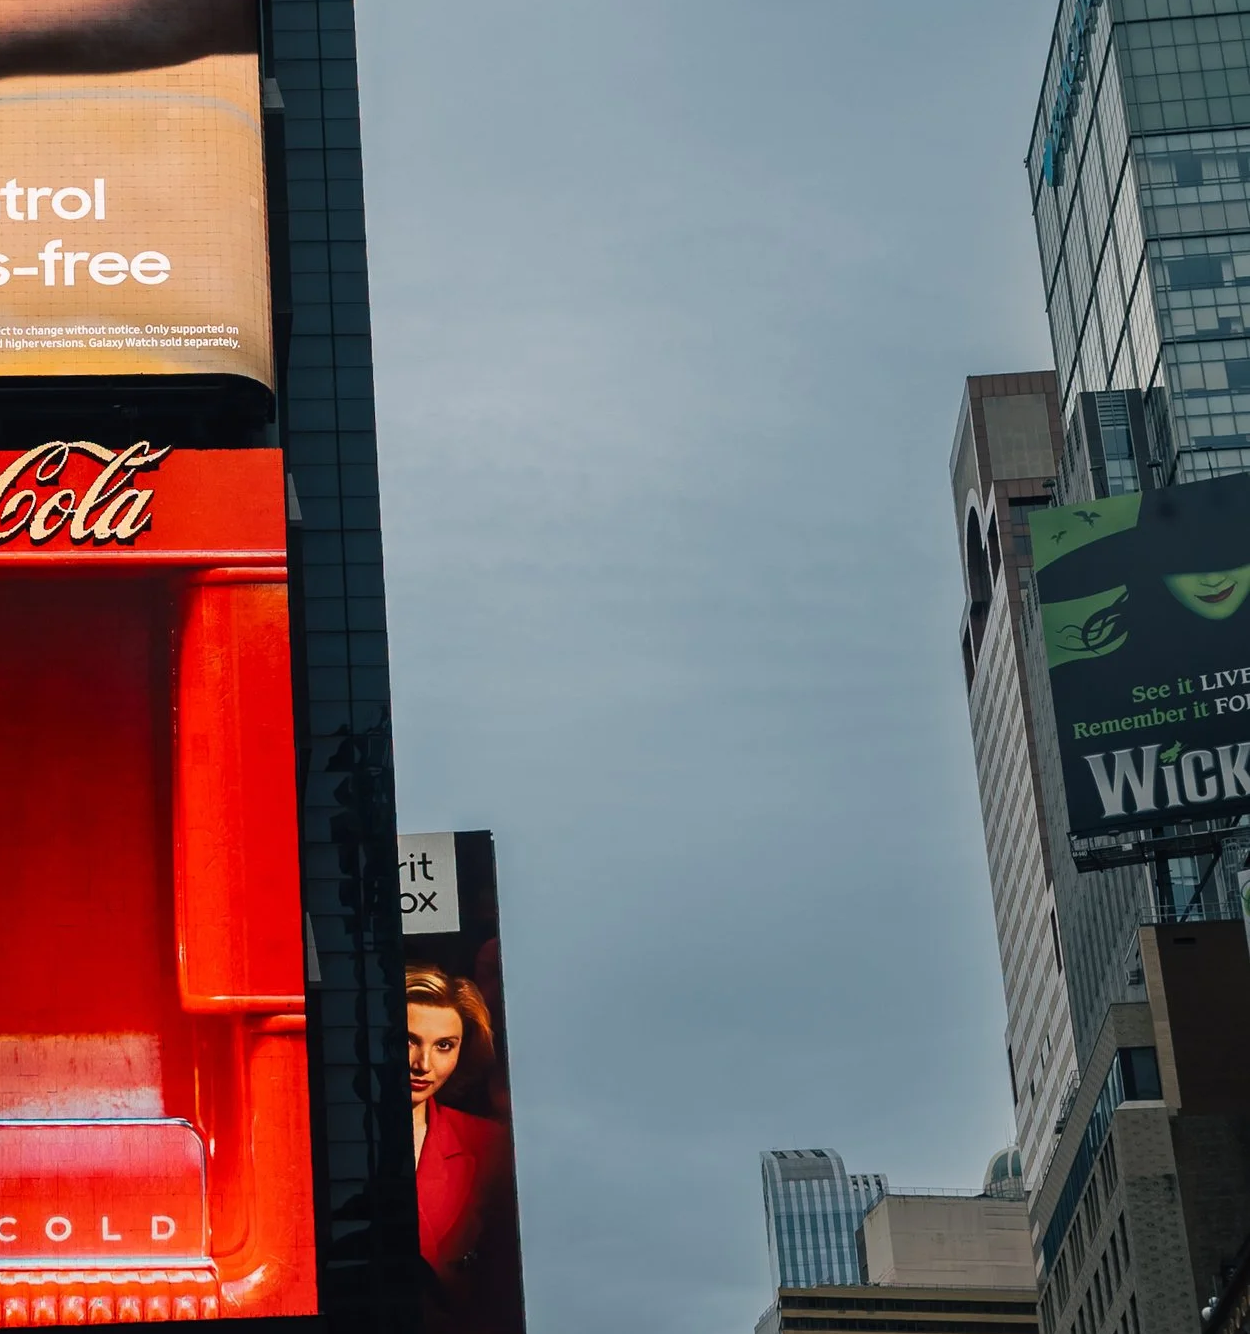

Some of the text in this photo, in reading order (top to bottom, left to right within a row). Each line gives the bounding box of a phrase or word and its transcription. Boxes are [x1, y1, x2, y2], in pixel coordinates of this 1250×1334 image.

[12, 326, 23, 335] to
[25, 325, 63, 337] change
[65, 325, 106, 335] without
[108, 324, 143, 335] notice.
[145, 324, 169, 337] Only
[171, 323, 224, 336] supported
[226, 326, 239, 335] on
[5, 338, 38, 351] higher
[39, 338, 86, 348] versions.
[88, 337, 124, 351] Galaxy
[125, 337, 158, 348] Watch
[159, 336, 182, 347] sold
[183, 336, 241, 349] separately.
[1132, 685, 1171, 703] See
[1177, 677, 1195, 696] it
[1073, 707, 1188, 740] Remember
[1193, 701, 1211, 719] it
